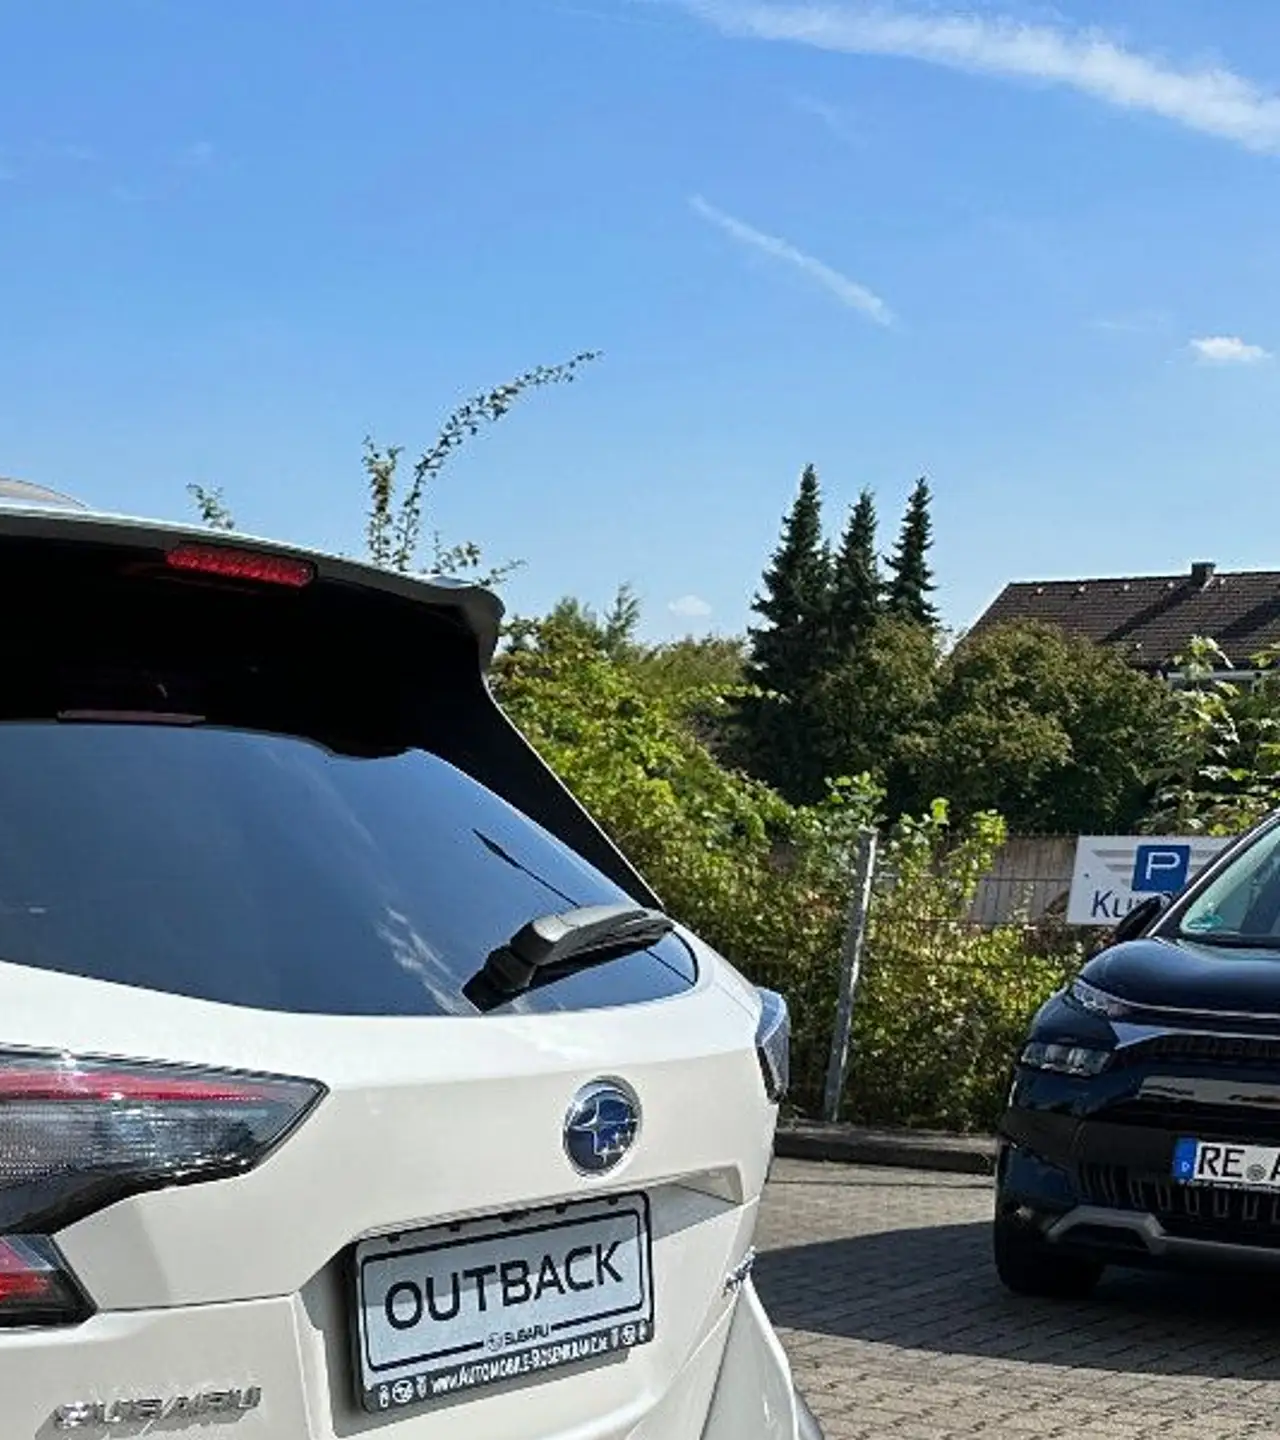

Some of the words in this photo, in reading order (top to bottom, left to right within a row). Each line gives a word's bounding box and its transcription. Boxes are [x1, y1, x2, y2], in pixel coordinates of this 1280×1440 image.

[1145, 852, 1181, 880] P
[1198, 1147, 1245, 1178] RE
[384, 1240, 624, 1330] OUTBACK
[502, 1323, 551, 1346] SUBARU
